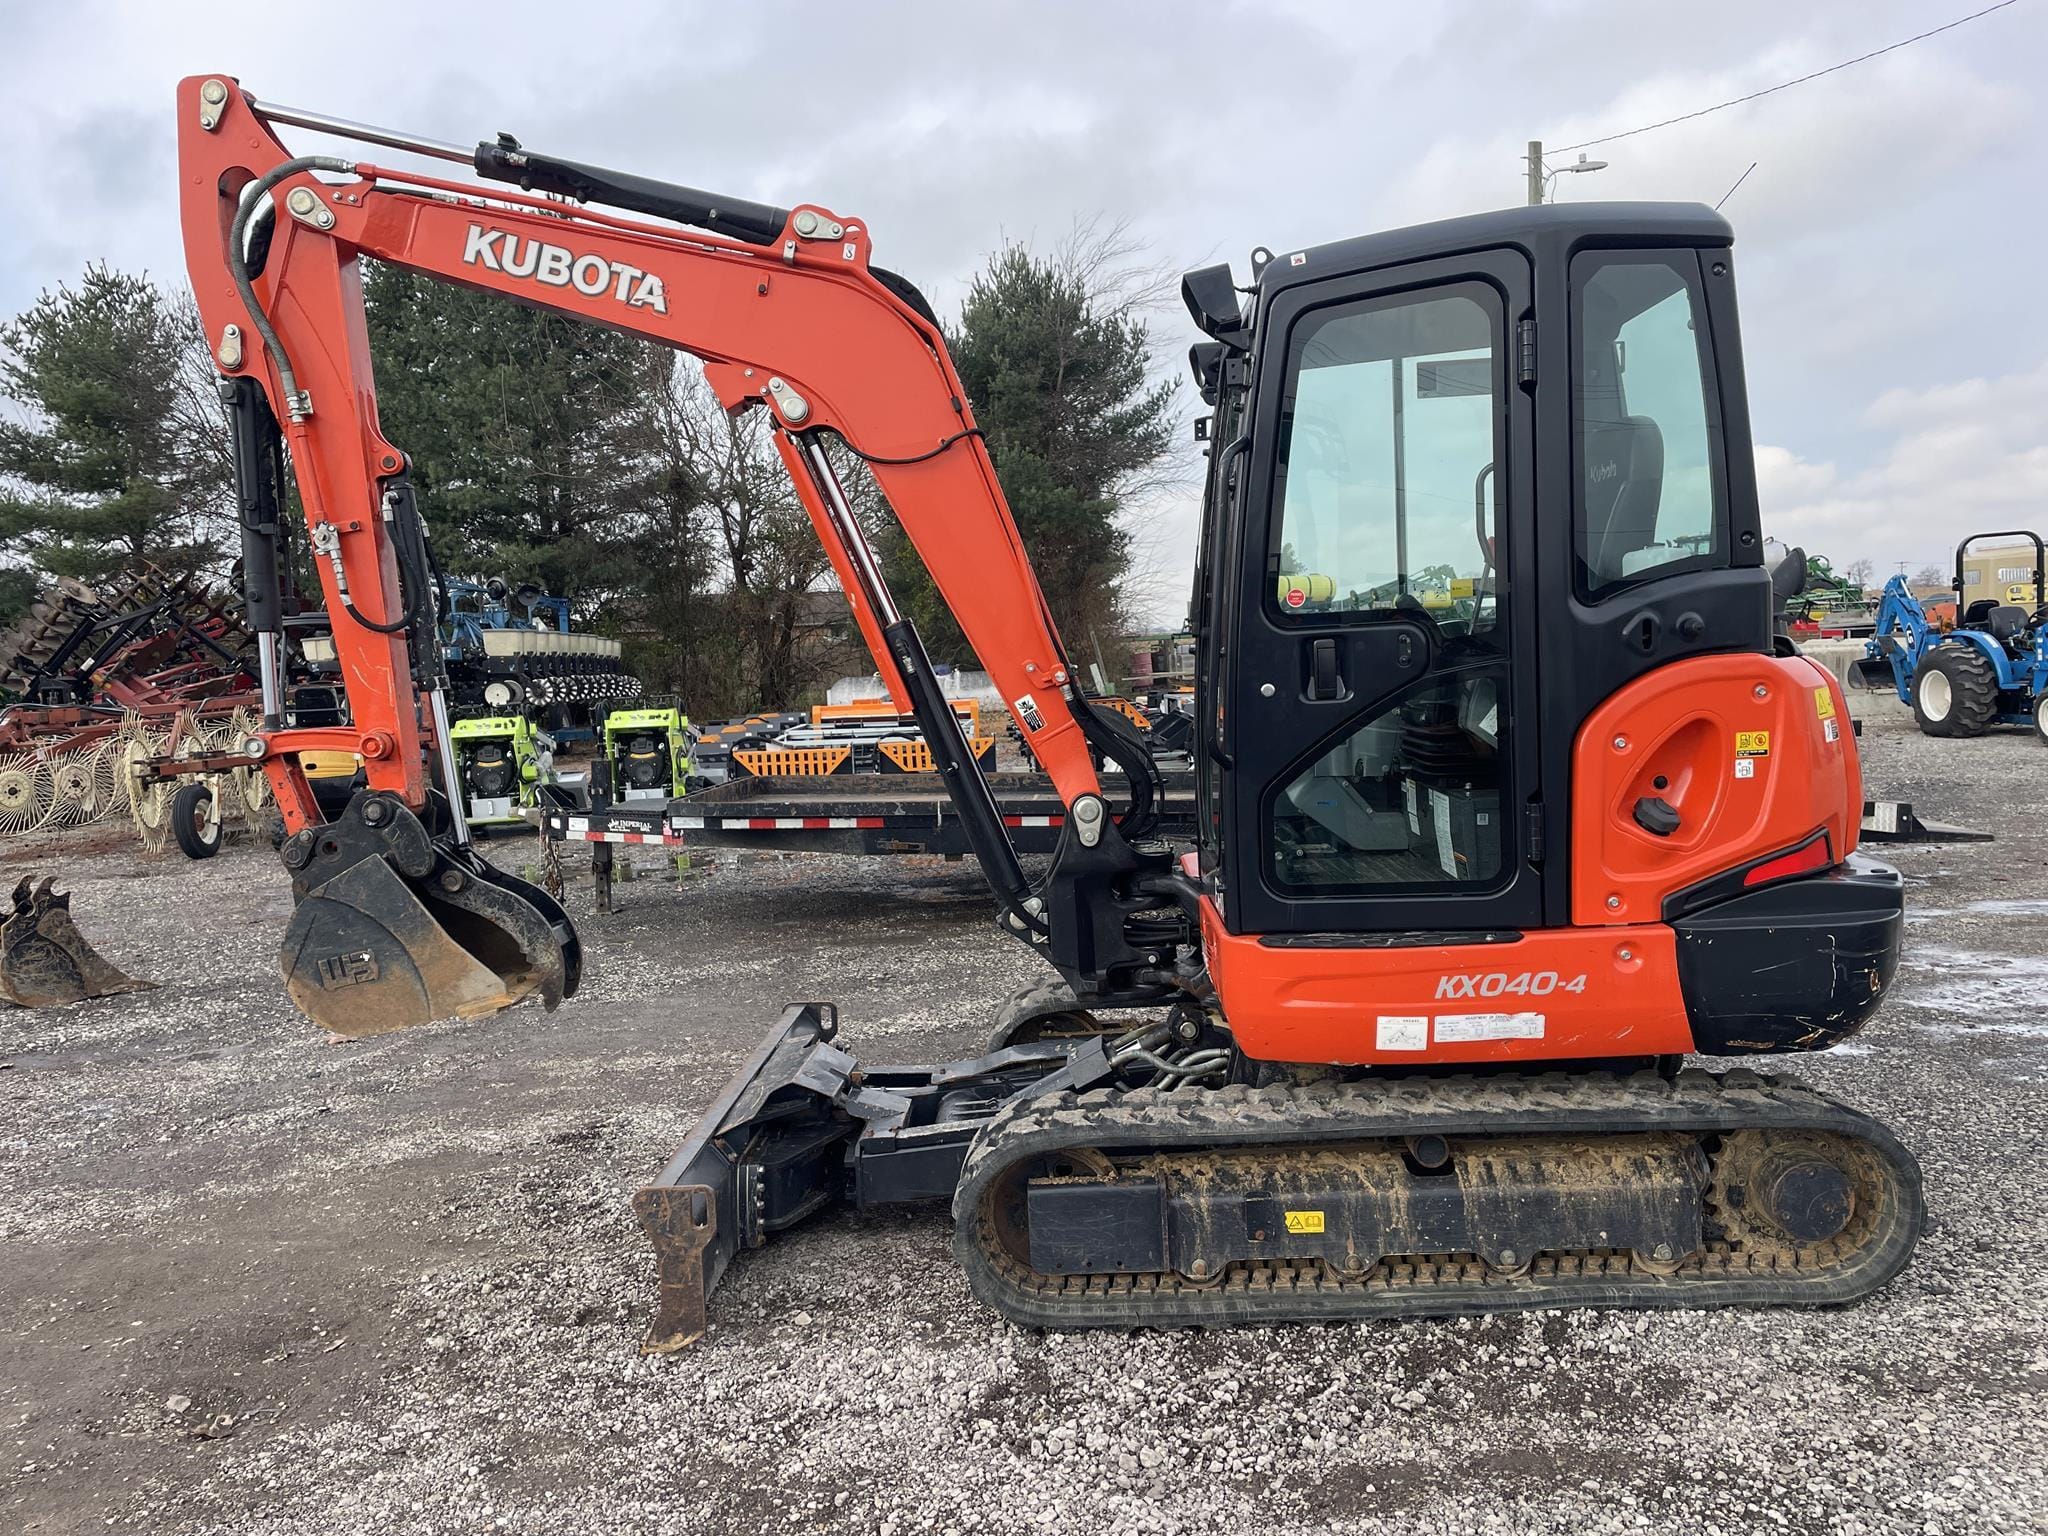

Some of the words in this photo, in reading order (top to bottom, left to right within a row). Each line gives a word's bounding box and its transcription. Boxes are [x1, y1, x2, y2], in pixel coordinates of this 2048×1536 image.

[463, 224, 668, 314] KUBOTA
[619, 819, 652, 831] IMPERIAL
[1434, 971, 1587, 1000] KX040-4
